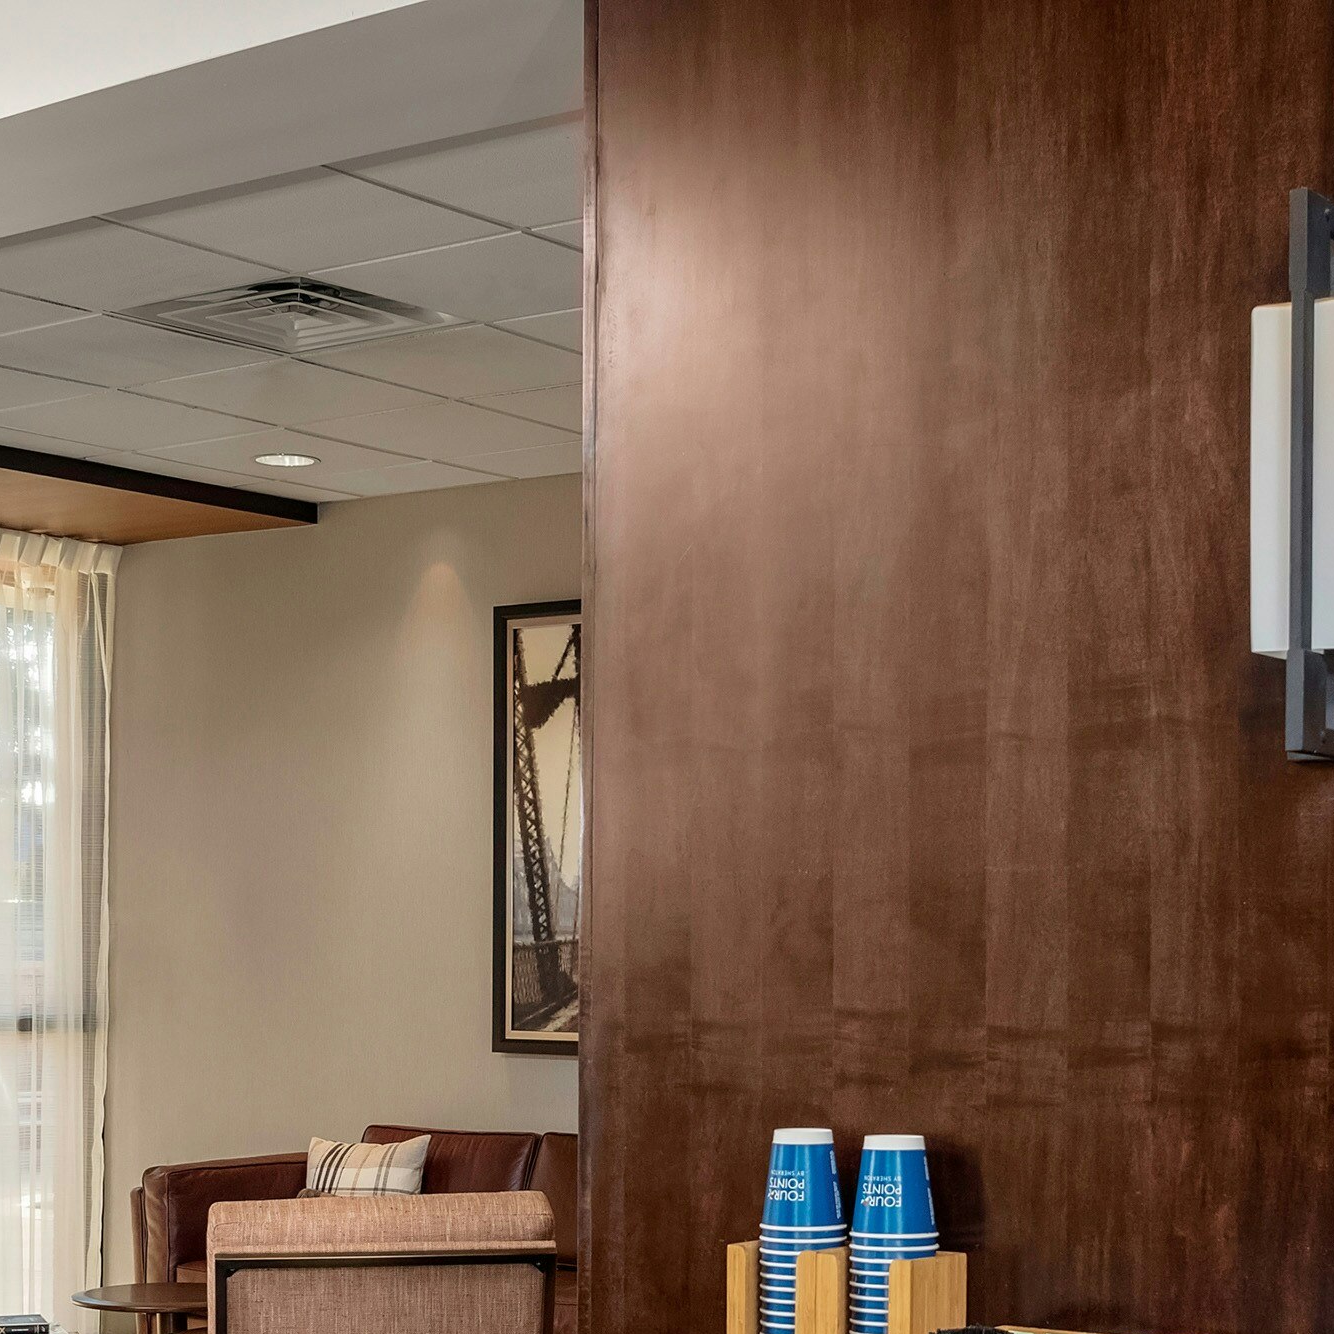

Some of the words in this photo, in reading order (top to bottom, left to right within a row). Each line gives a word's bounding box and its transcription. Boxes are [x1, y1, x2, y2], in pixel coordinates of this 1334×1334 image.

[795, 1169, 805, 1177] BY
[769, 1177, 805, 1190] POINTS
[862, 1182, 902, 1195] POINTS
[773, 1190, 805, 1202] FOUR
[868, 1195, 902, 1208] FOUR
